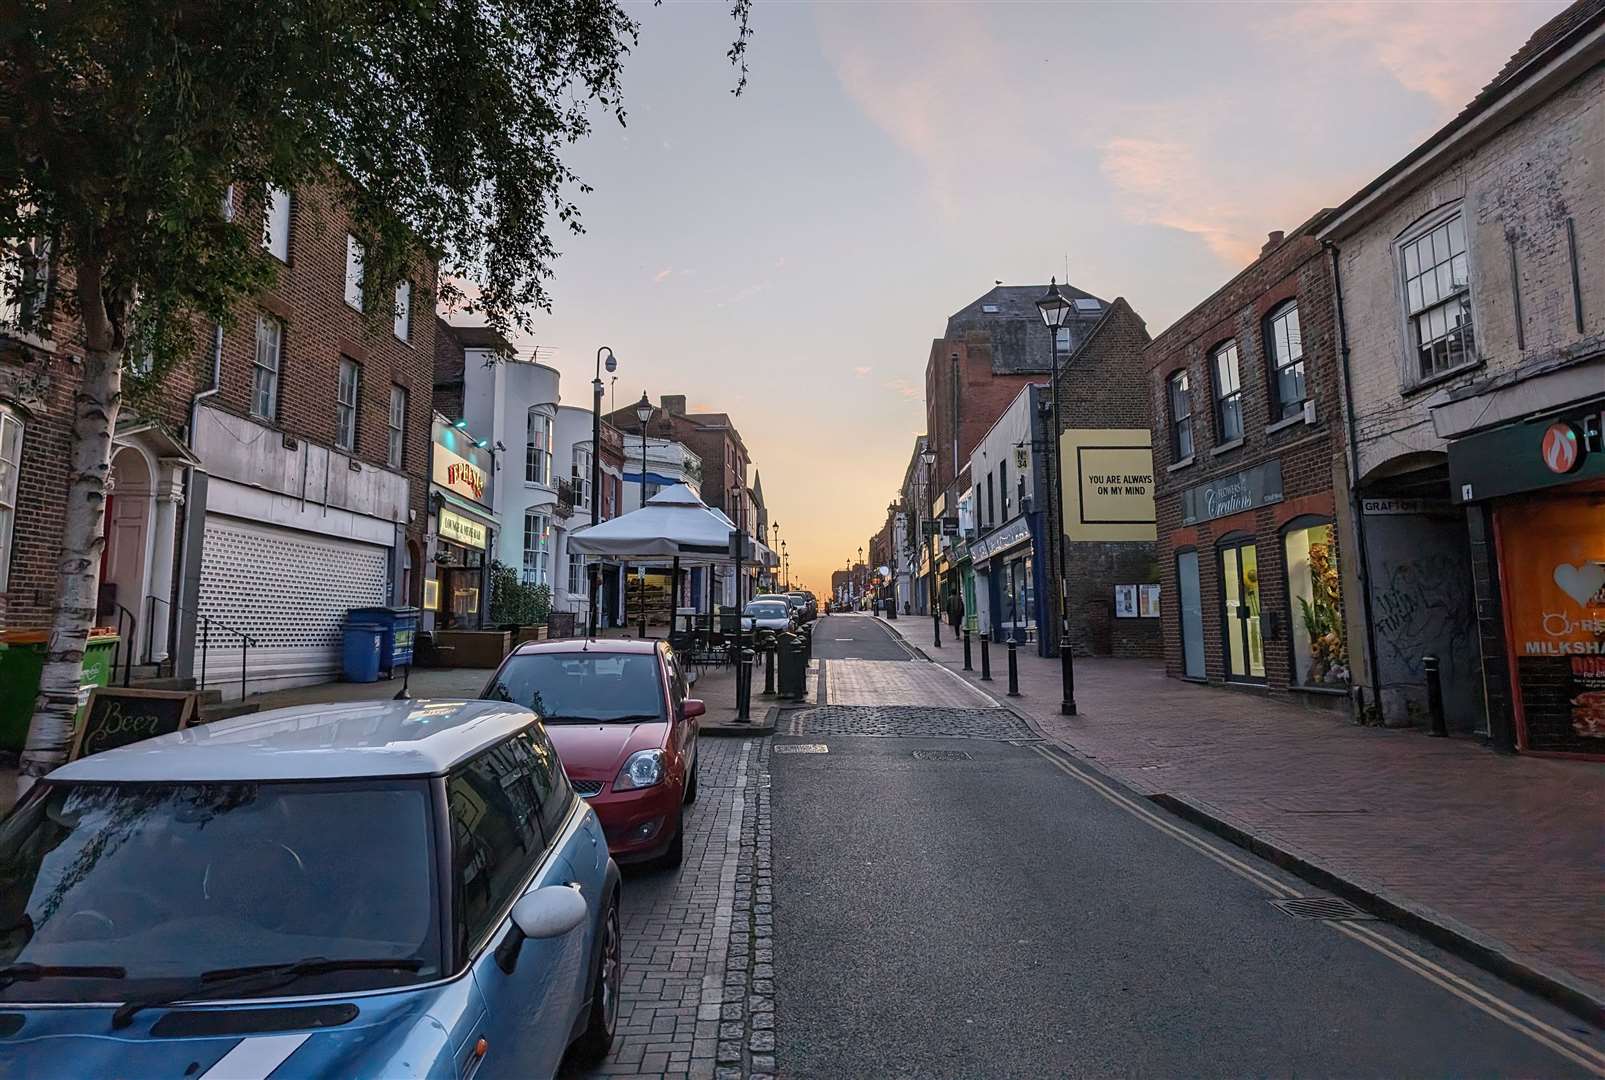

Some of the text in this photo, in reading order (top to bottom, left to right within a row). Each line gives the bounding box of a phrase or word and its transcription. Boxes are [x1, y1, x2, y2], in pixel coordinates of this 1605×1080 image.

[1089, 475, 1152, 484] YOU ARE ALWAYS
[1097, 486, 1146, 495] ON MY MIND
[94, 700, 159, 741] Beer
